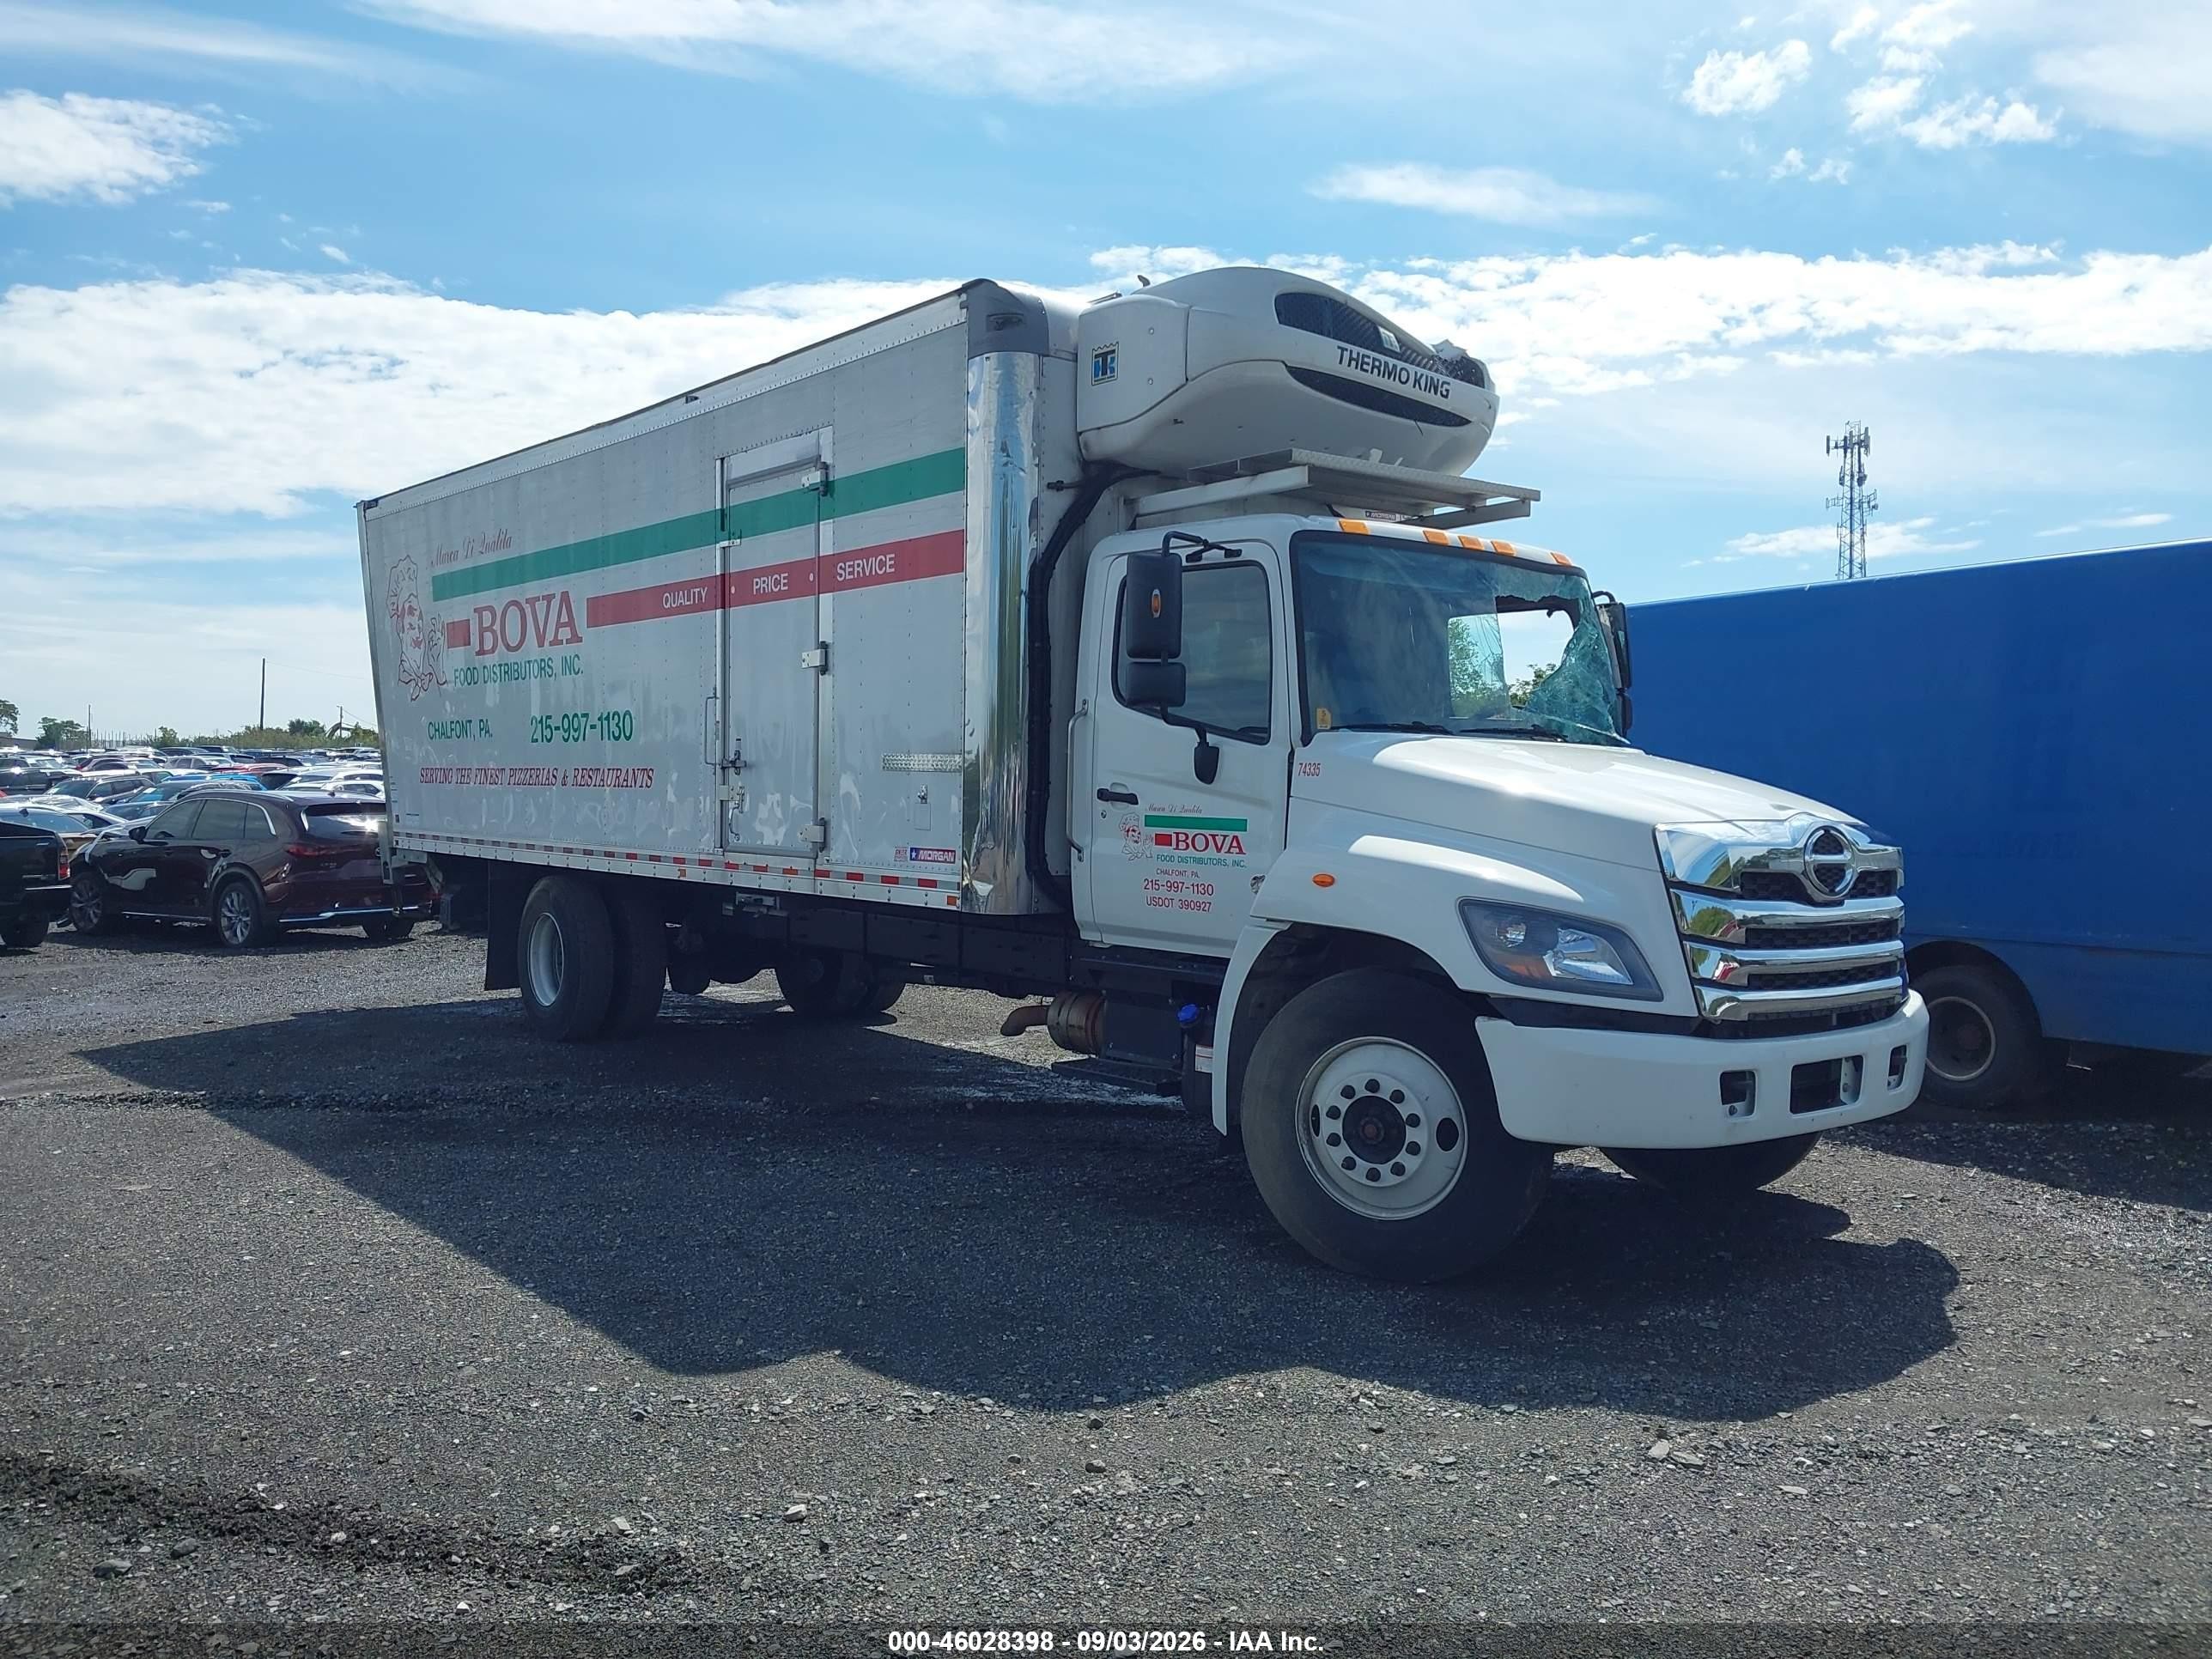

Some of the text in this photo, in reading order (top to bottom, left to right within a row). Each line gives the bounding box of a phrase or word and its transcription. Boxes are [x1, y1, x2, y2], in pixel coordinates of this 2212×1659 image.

[1337, 345, 1450, 399] THERMO KING
[662, 554, 896, 609] QUALITY PRICE SERVICE
[473, 590, 583, 657] BOVA
[453, 653, 584, 688] FOOD DISTRIBUTORS, INC.
[428, 719, 493, 742] CHALFONT, PA.
[530, 709, 634, 744] 215-997-1130
[420, 768, 654, 788] SERVING THE FINEST PIZZERIAS & RESTAURANTS
[1297, 762, 1322, 777] 74335
[1172, 831, 1246, 855] BOVA
[918, 850, 956, 863] MORGAN
[1156, 854, 1247, 869] FOOD DISTRIBUTORS, INC.
[1156, 867, 1200, 879] CHALFONT, PA.
[1143, 878, 1214, 896] 215-997-1130
[1146, 896, 1212, 913] USDOT 390927
